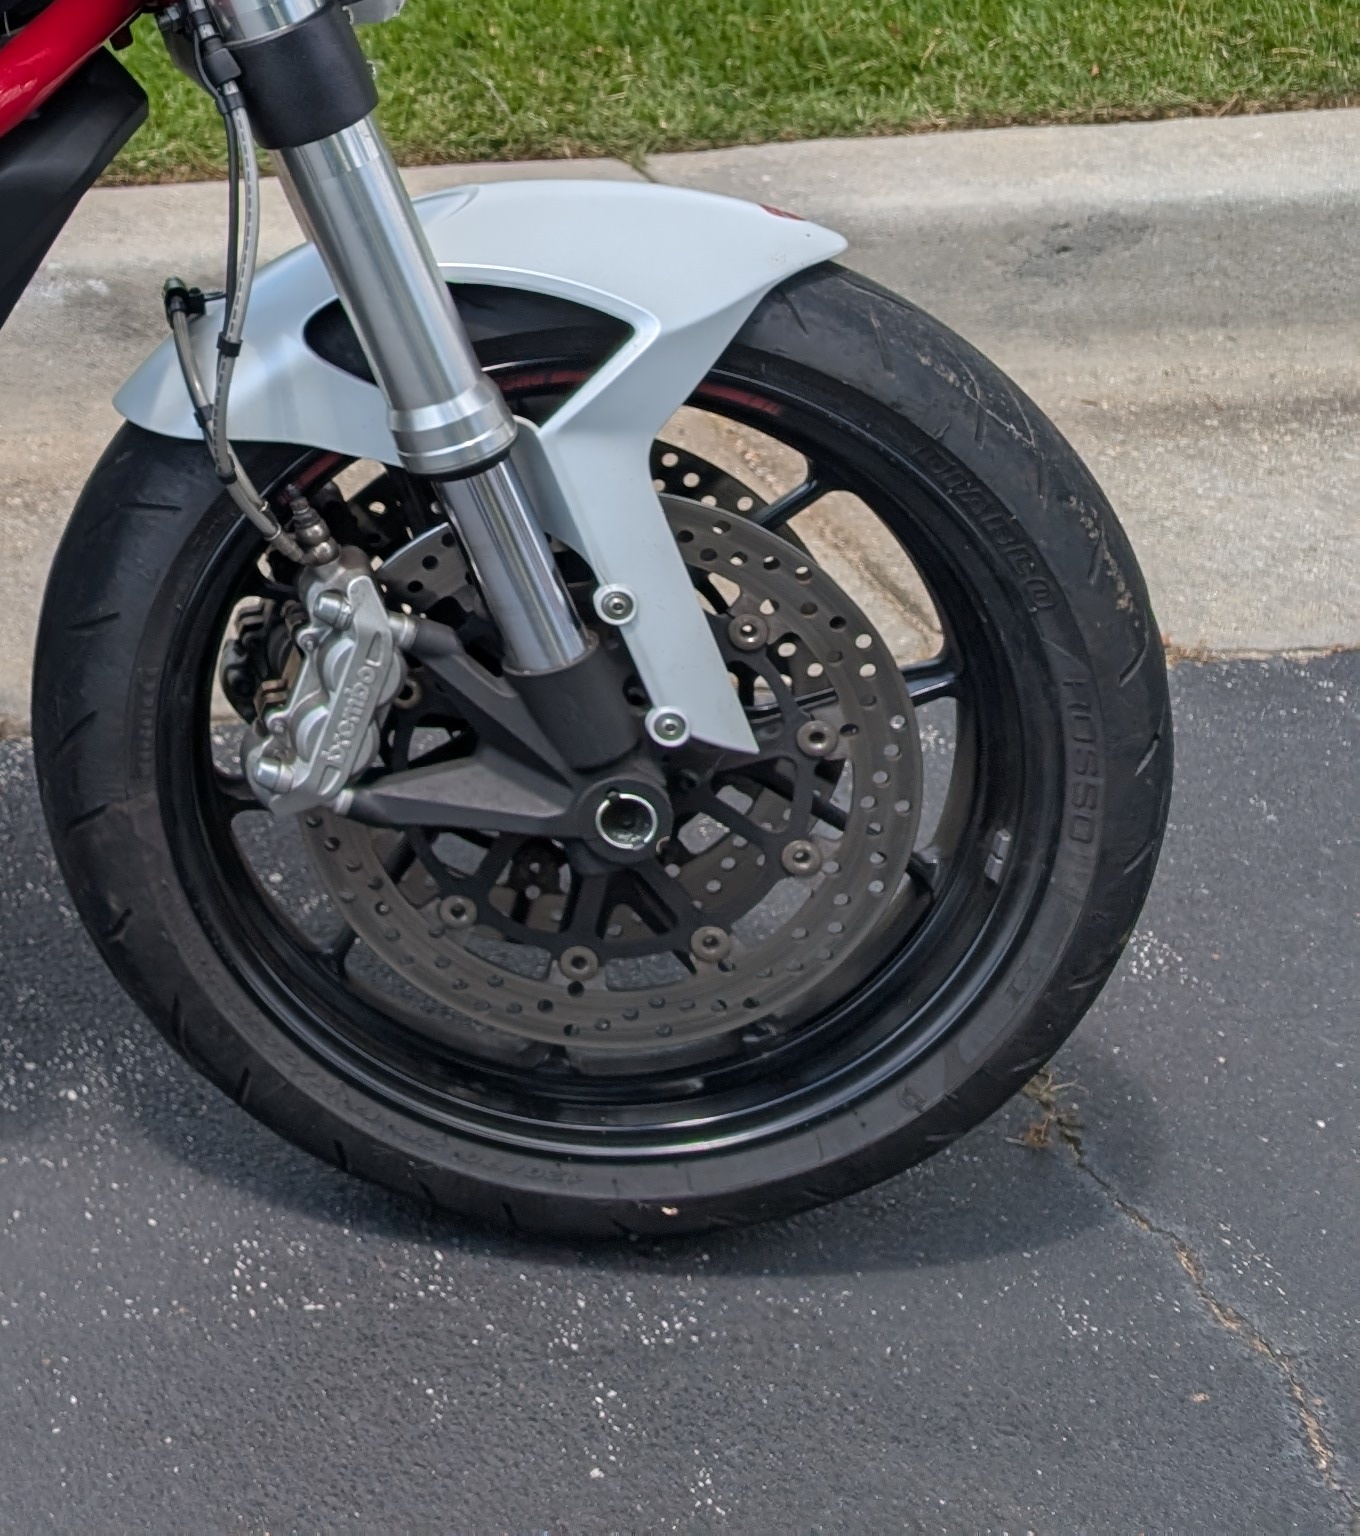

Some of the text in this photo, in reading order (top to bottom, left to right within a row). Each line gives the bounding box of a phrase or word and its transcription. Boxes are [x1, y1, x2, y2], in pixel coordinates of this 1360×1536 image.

[321, 665, 376, 763] brembo
[913, 448, 1054, 611] DIABLO
[1061, 677, 1104, 845] ROSSO
